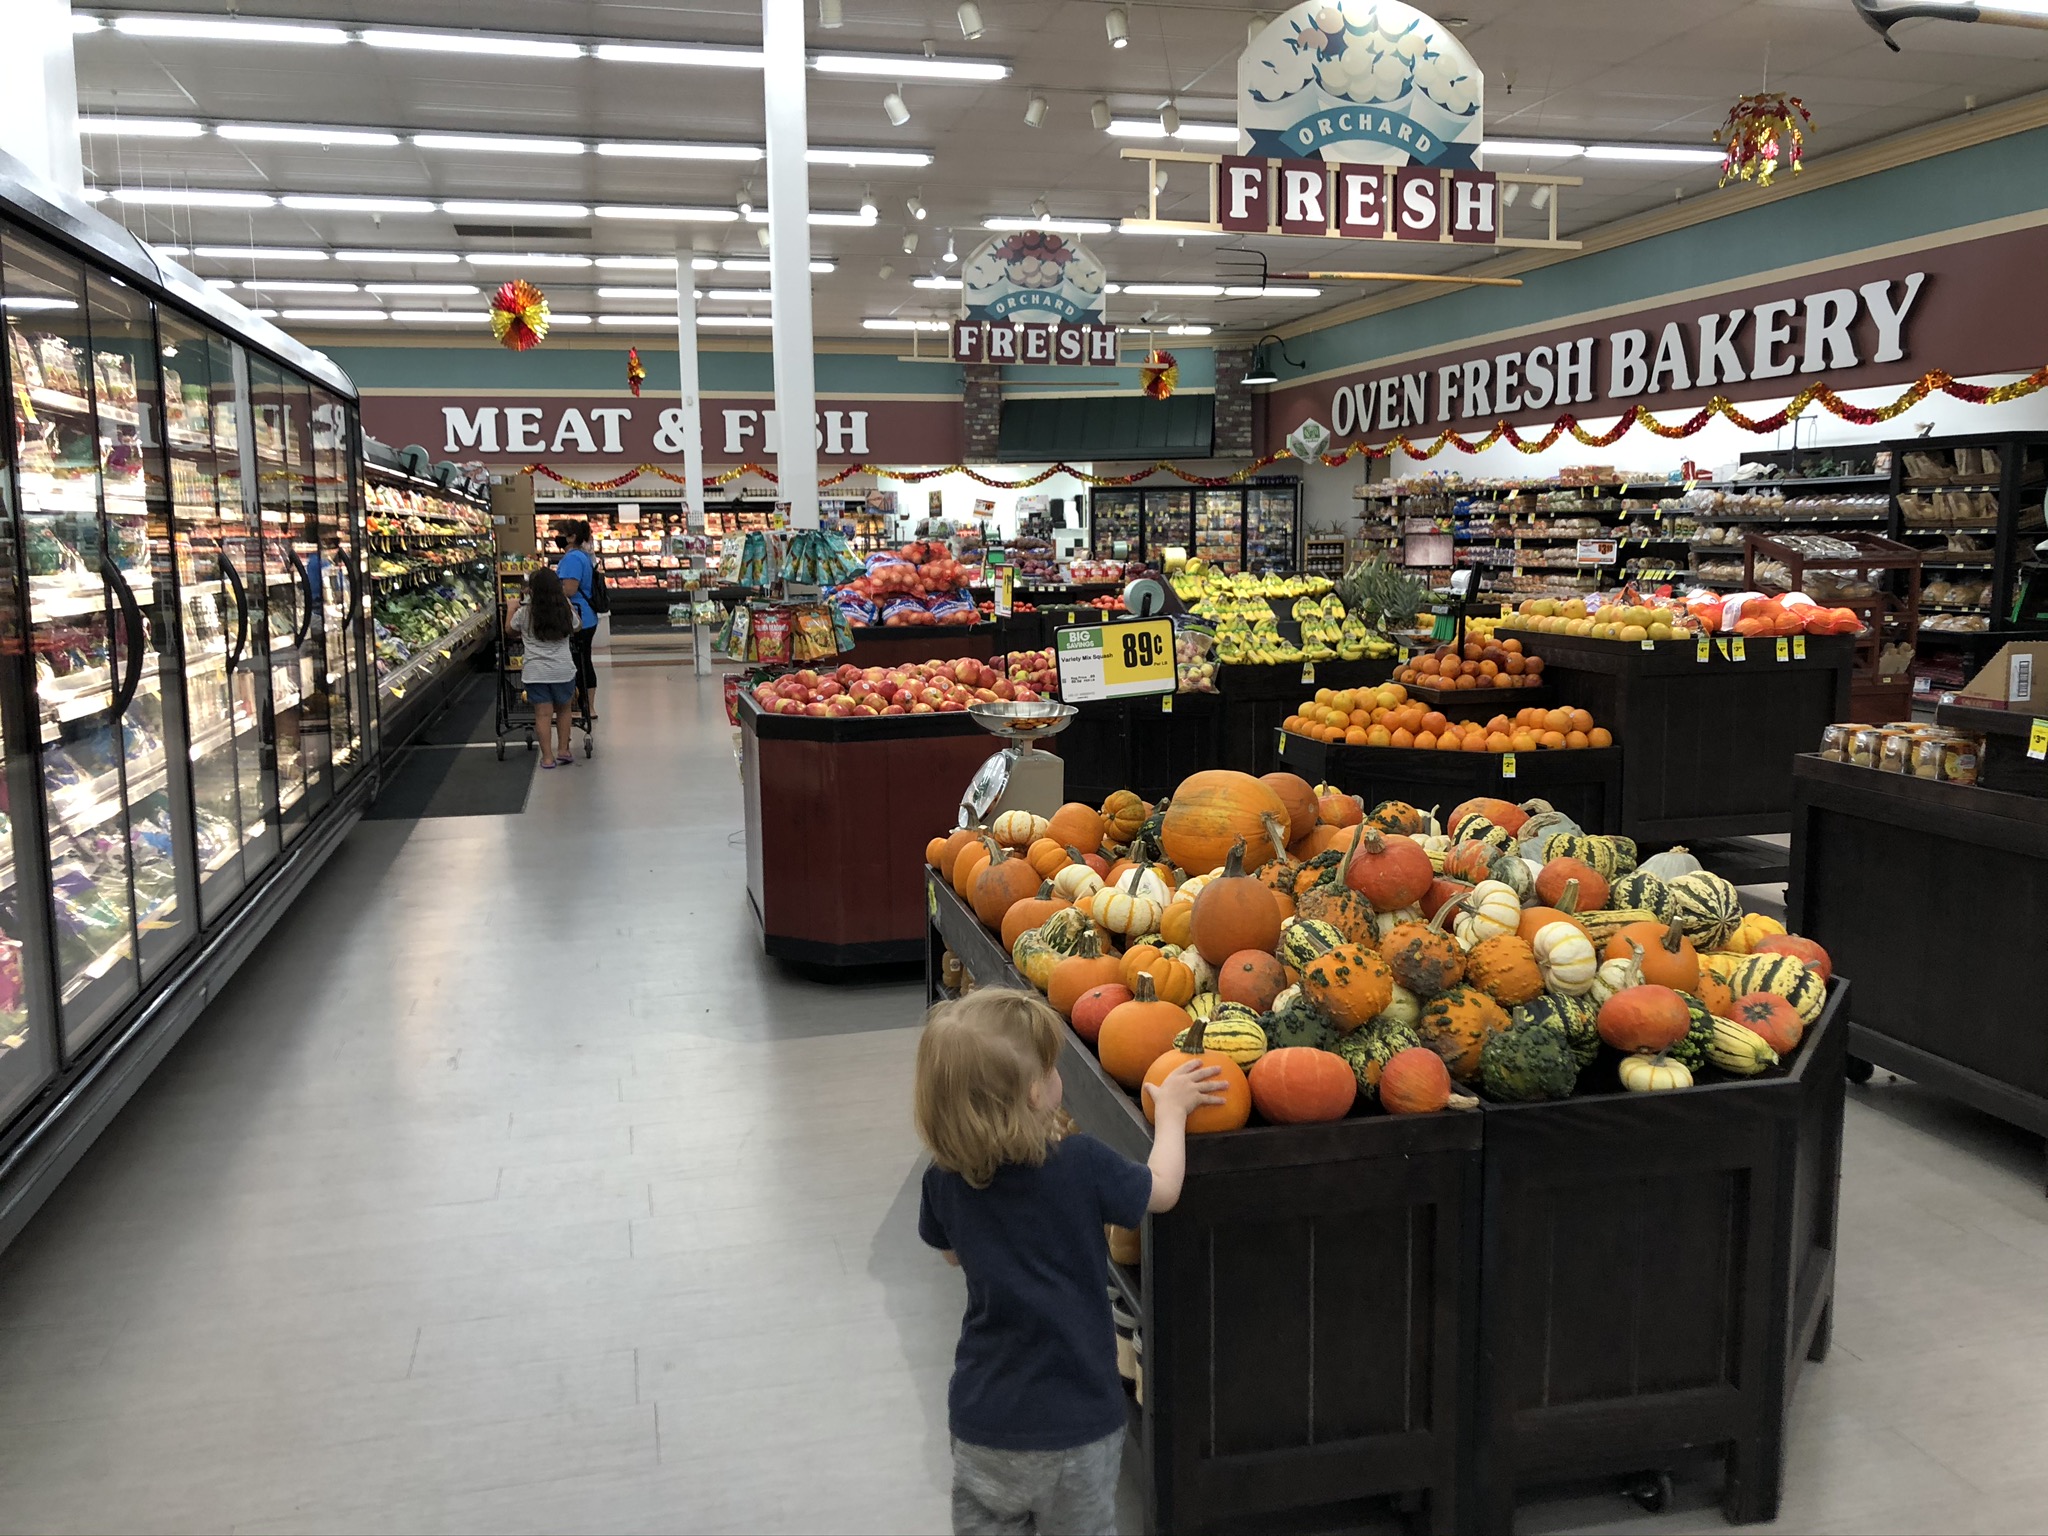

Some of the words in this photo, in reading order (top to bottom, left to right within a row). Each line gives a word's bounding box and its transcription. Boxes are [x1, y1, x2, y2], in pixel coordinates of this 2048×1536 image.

[1298, 113, 1432, 153] ORCHARD
[1228, 166, 1495, 233] FRESH
[995, 293, 1075, 317] ORCHARD
[957, 325, 1116, 361] FRESH
[1331, 370, 1428, 437] OVEN
[1437, 336, 1595, 422] FRESH
[1609, 271, 1926, 398] BAKERY
[441, 406, 632, 454] MEAT
[652, 407, 702, 454] &
[722, 409, 870, 455] FIH
[1066, 640, 1095, 650] SAVINGS
[1069, 630, 1091, 642] BIG
[1061, 655, 1082, 663] Variety
[1082, 653, 1092, 661] Mix
[1093, 652, 1113, 660] Squash
